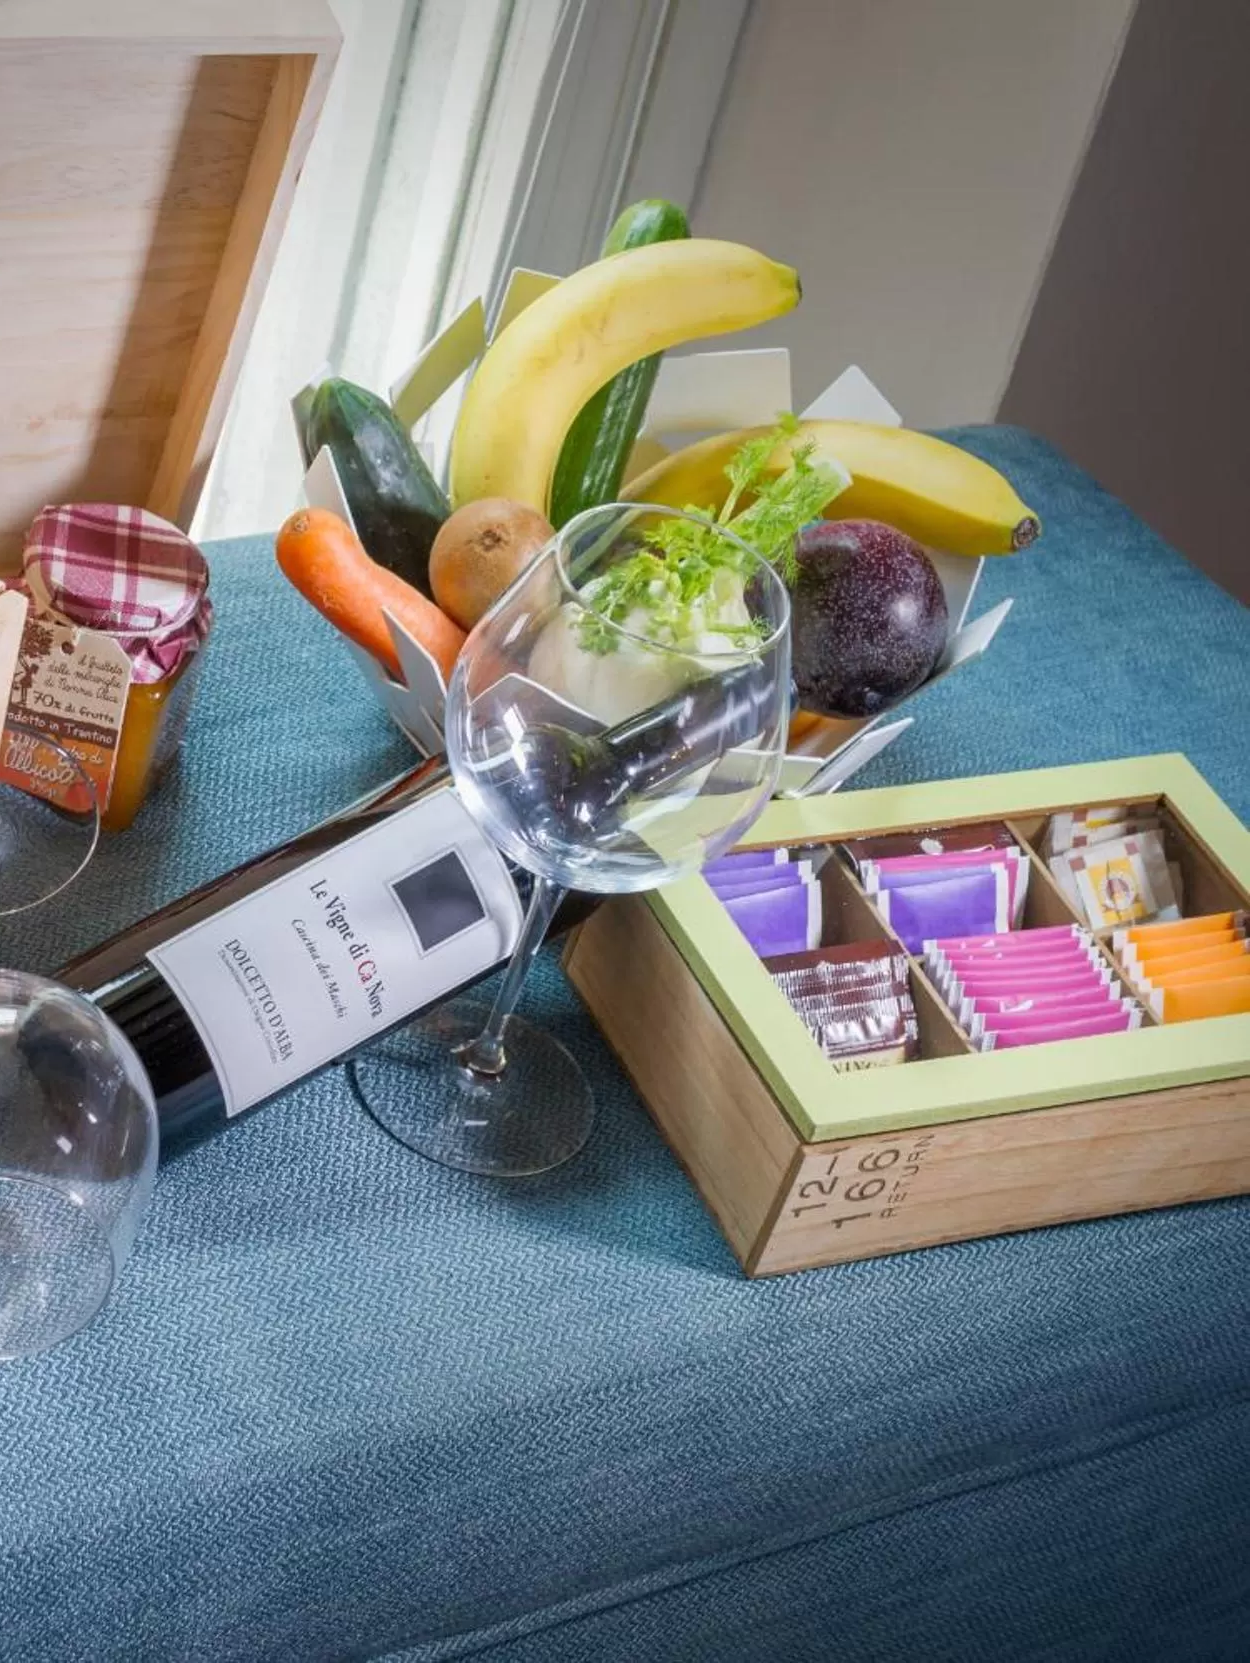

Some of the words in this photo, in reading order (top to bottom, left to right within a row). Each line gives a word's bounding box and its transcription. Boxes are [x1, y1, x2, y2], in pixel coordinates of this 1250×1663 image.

[6, 710, 46, 728] odotto
[63, 722, 113, 745] Trentino
[309, 878, 328, 901] Le
[326, 895, 355, 942] Vigne
[349, 942, 371, 962] di
[363, 979, 385, 1018] Nova
[315, 961, 333, 982] dei
[223, 938, 278, 1014] DOLCETTO
[268, 1010, 294, 1062] D'ALBA
